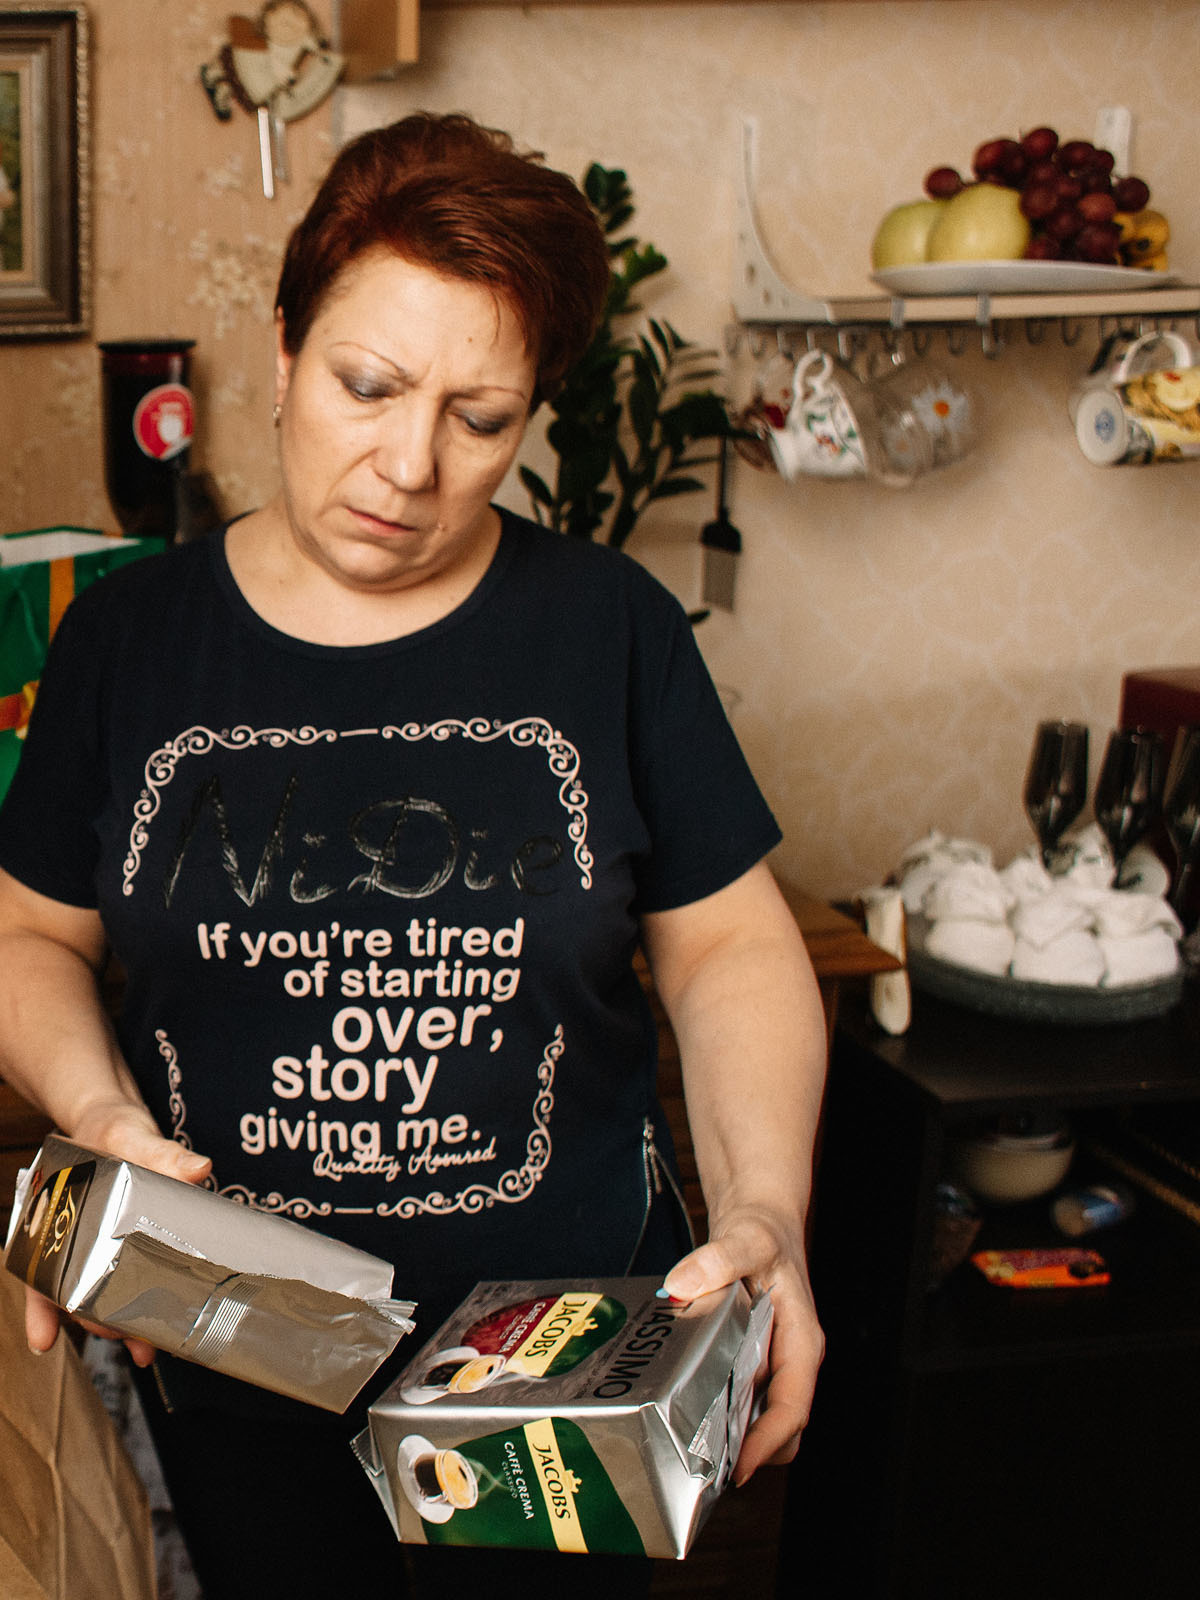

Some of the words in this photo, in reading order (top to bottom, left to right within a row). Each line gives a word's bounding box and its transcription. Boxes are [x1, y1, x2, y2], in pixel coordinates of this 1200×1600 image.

[197, 922, 231, 960] If
[240, 921, 392, 968] you're
[406, 917, 525, 959] tired
[283, 960, 330, 998] of
[340, 960, 521, 1003] starting
[331, 1003, 504, 1054] over,
[271, 1044, 438, 1115] story
[239, 1106, 381, 1162] giving
[397, 1113, 482, 1151] me.
[312, 1149, 402, 1183] Quality
[407, 1136, 497, 1175] Assured
[525, 1300, 587, 1358] JACOBS
[593, 1302, 694, 1398] TASSIMO
[515, 1477, 534, 1520] CREMA
[532, 1443, 571, 1519] JACOBS
